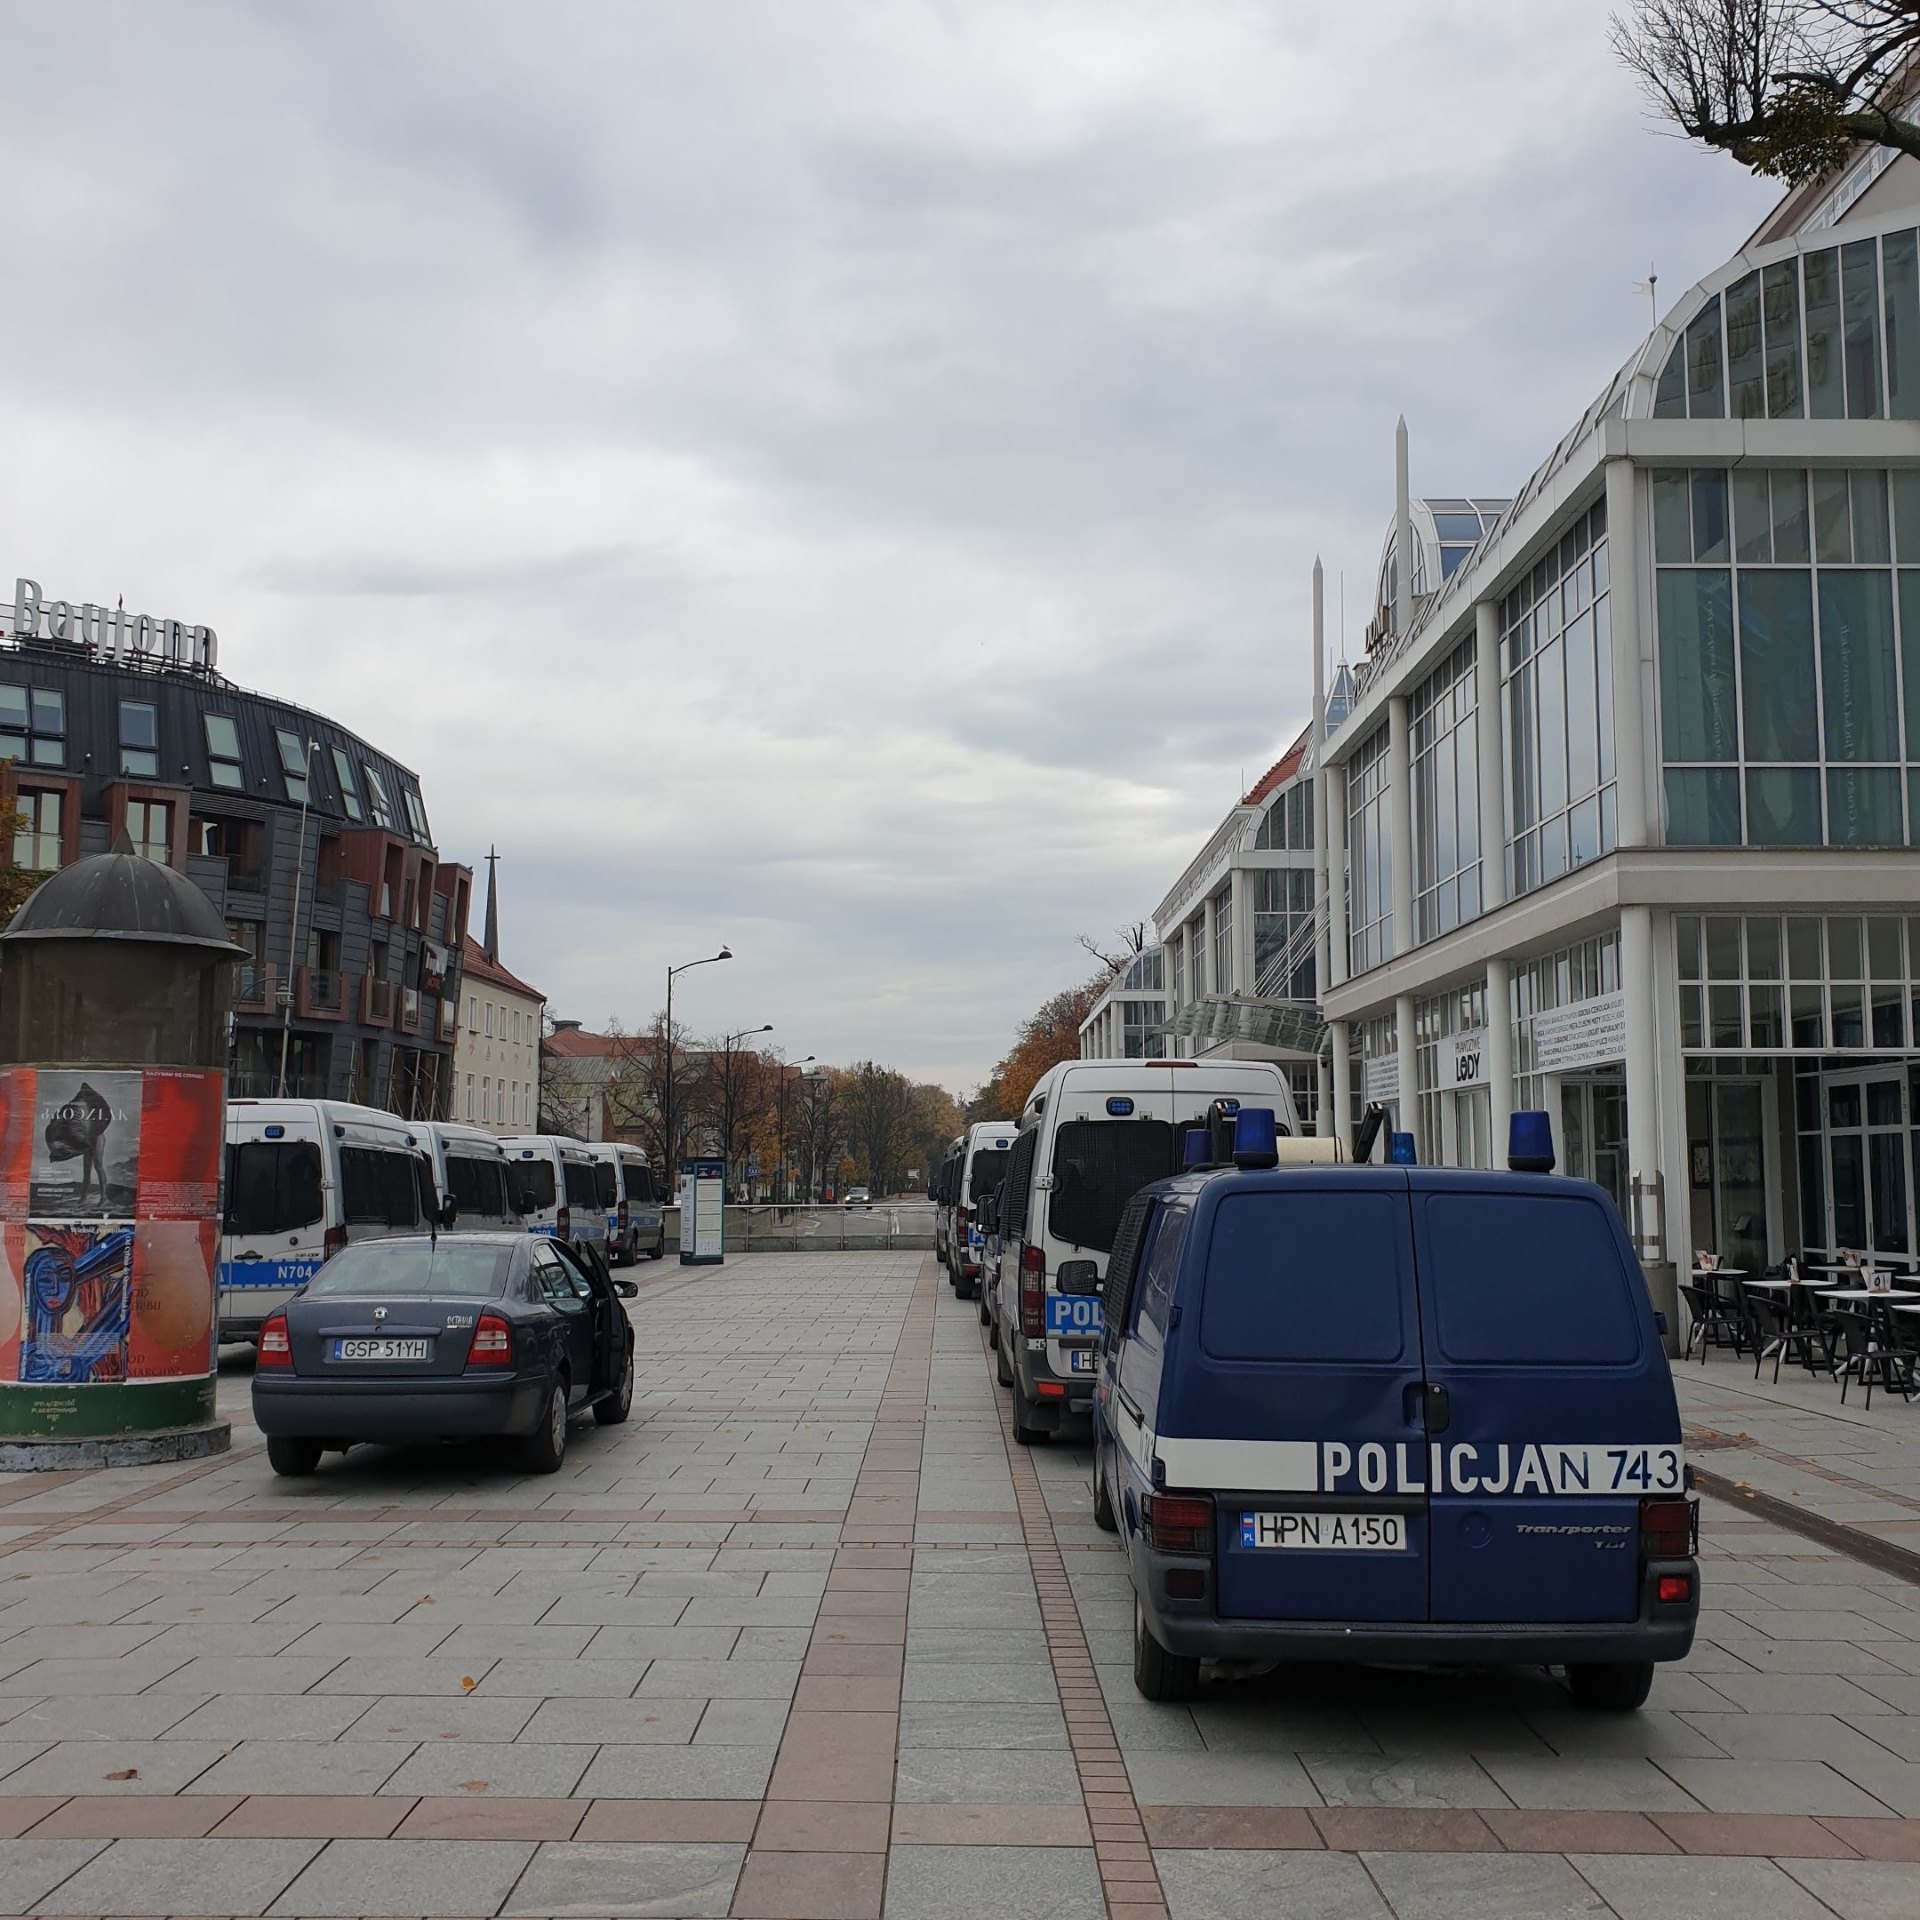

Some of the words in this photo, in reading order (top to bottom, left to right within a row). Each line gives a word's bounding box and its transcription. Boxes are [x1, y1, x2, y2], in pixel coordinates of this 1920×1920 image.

[1455, 1052, 1480, 1082] LODY
[277, 1265, 312, 1278] N704
[447, 1315, 473, 1325] OCTAVIA
[1055, 1301, 1103, 1326] POL
[344, 1340, 379, 1358] GSP
[384, 1340, 425, 1359] 51YH
[1323, 1442, 1549, 1494] POLICJA
[1559, 1454, 1590, 1489] N
[1607, 1449, 1680, 1490] 743
[1259, 1514, 1320, 1547] HPN
[1331, 1517, 1399, 1546] A150
[1516, 1523, 1632, 1536] Transporter
